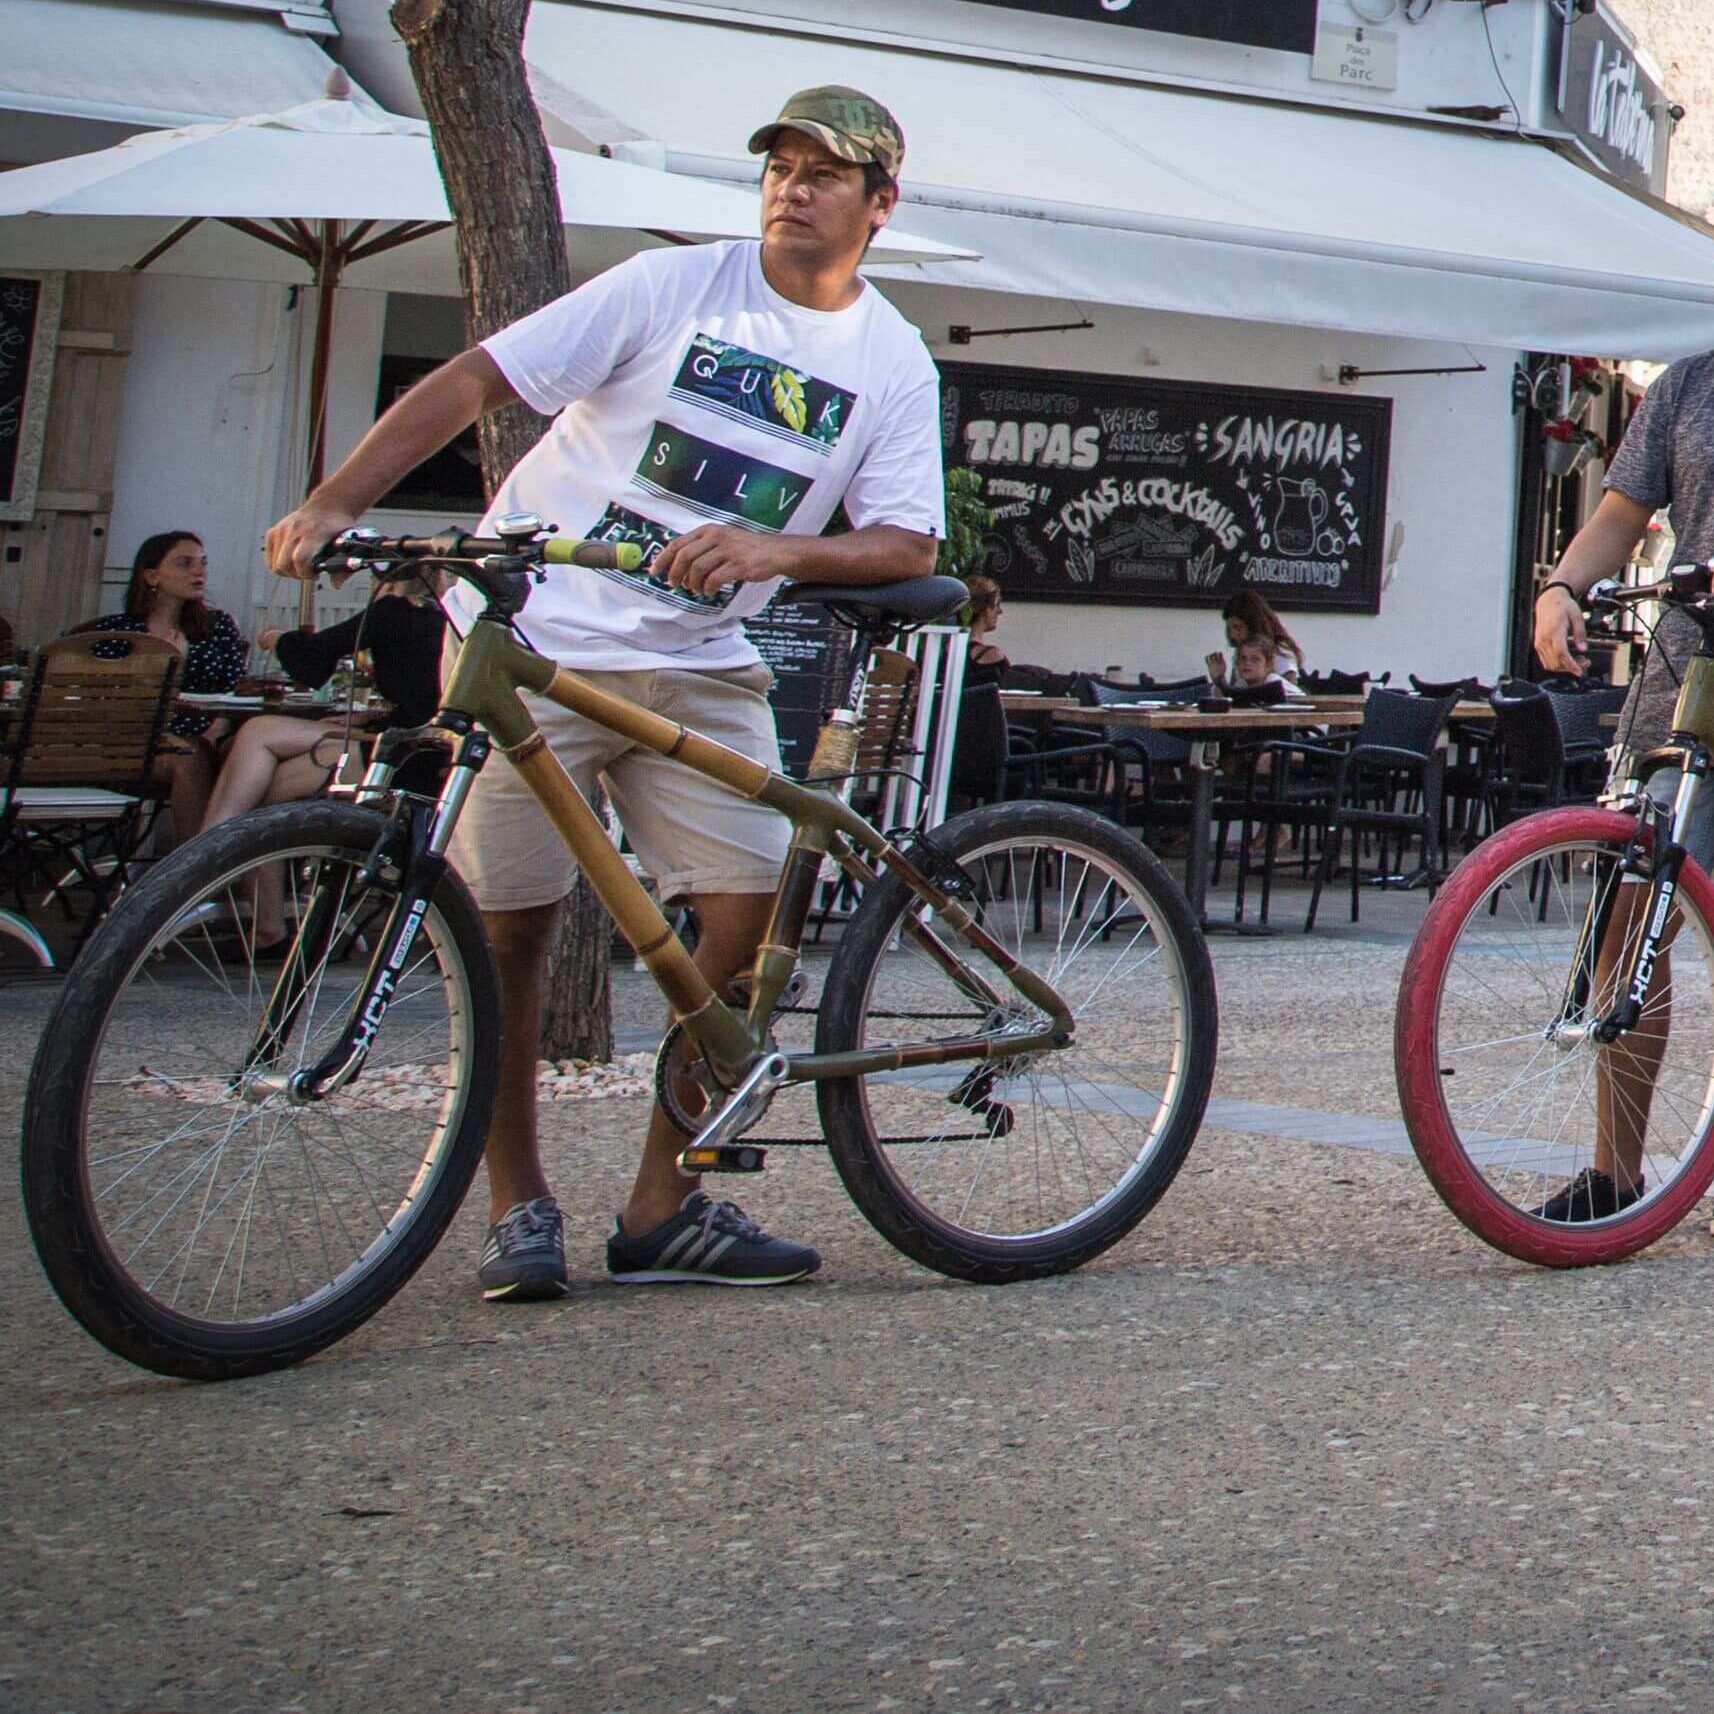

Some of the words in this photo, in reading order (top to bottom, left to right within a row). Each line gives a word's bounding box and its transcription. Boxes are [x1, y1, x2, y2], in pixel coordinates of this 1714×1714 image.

[1340, 64, 1373, 80] Parc
[692, 354, 841, 427] QUIK
[653, 442, 798, 511] SILV
[966, 419, 1101, 470] TAPAS
[1207, 415, 1344, 473] SANGRIA
[1122, 480, 1138, 506] &
[1137, 477, 1246, 550] COCKTAILS
[1335, 492, 1362, 546] CAVA
[1630, 939, 1658, 1005] XCT
[353, 970, 395, 1051] XCT
